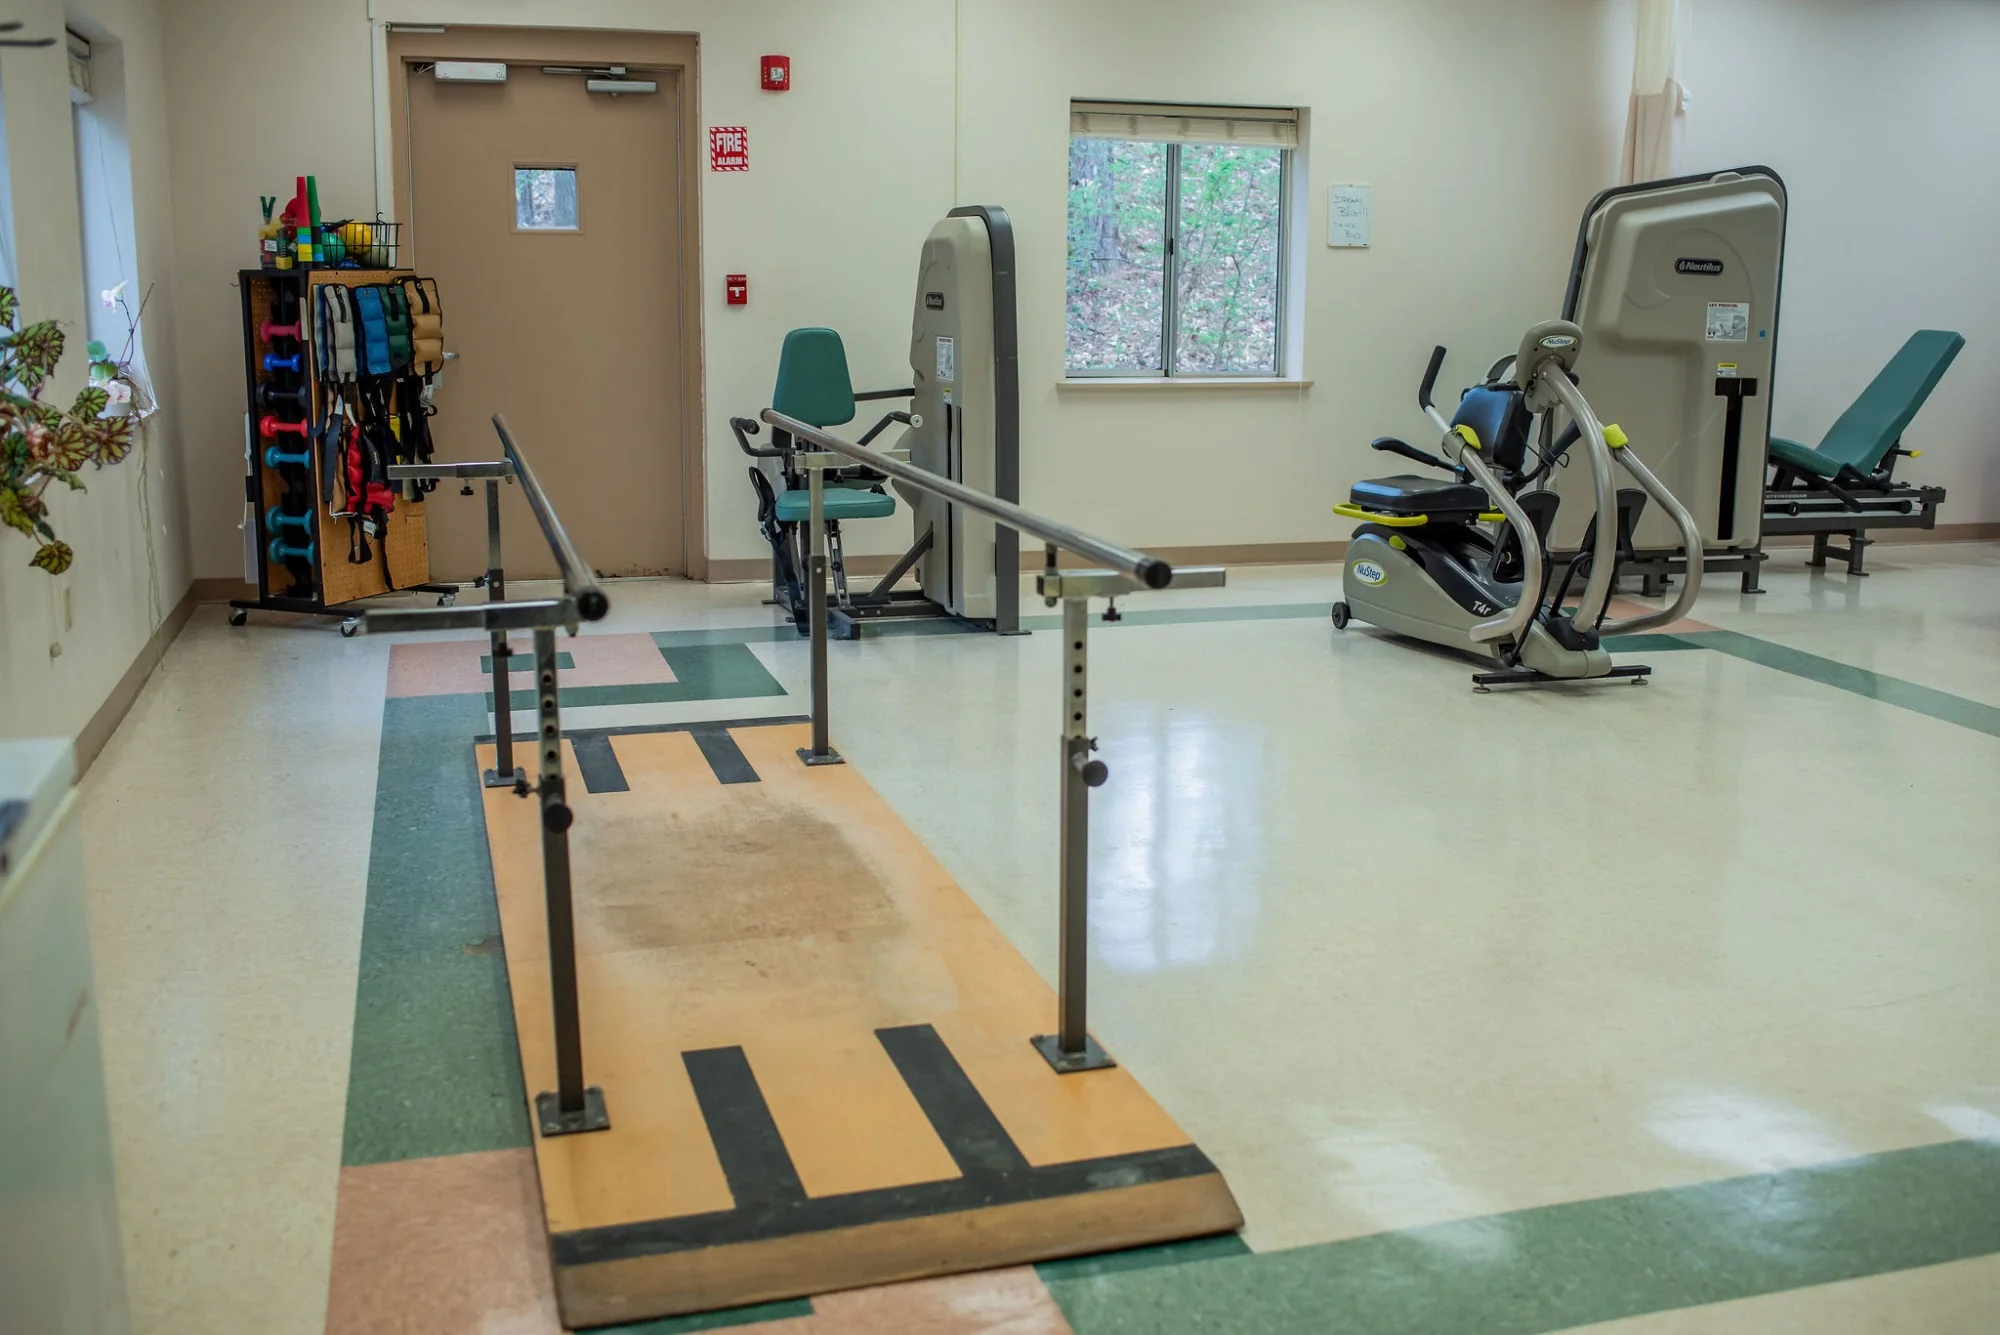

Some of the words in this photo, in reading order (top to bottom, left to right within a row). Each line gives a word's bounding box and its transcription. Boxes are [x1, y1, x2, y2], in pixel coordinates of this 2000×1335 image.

[716, 132, 742, 155] FIRE
[717, 156, 743, 166] ALARM
[1332, 195, 1363, 206] DREAM
[1685, 261, 1721, 272] Nautilus
[1545, 338, 1571, 346] NuStep
[1356, 563, 1381, 581] NuStep
[1472, 600, 1492, 615] T4r
